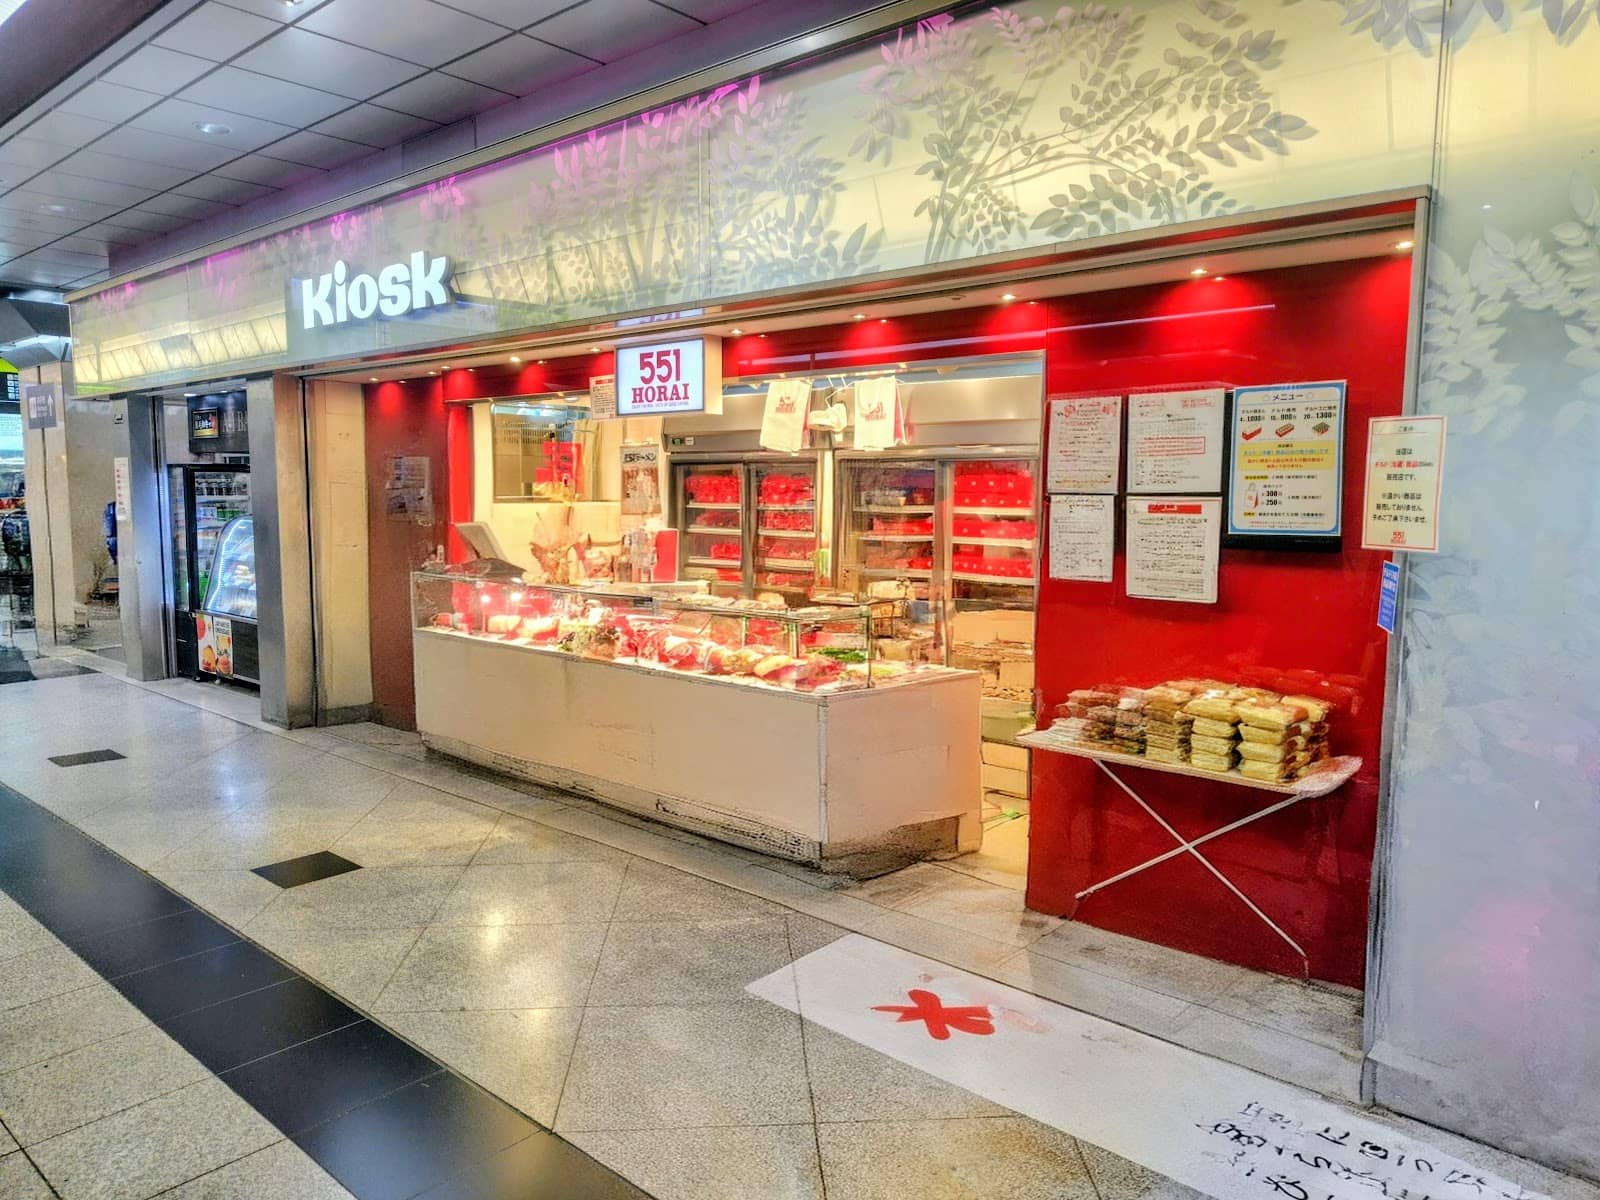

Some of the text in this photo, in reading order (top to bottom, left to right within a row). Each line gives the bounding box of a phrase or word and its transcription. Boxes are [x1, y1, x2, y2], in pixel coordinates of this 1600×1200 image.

[302, 250, 448, 330] Kiosk
[639, 348, 681, 385] 551
[631, 383, 690, 404] HORAI
